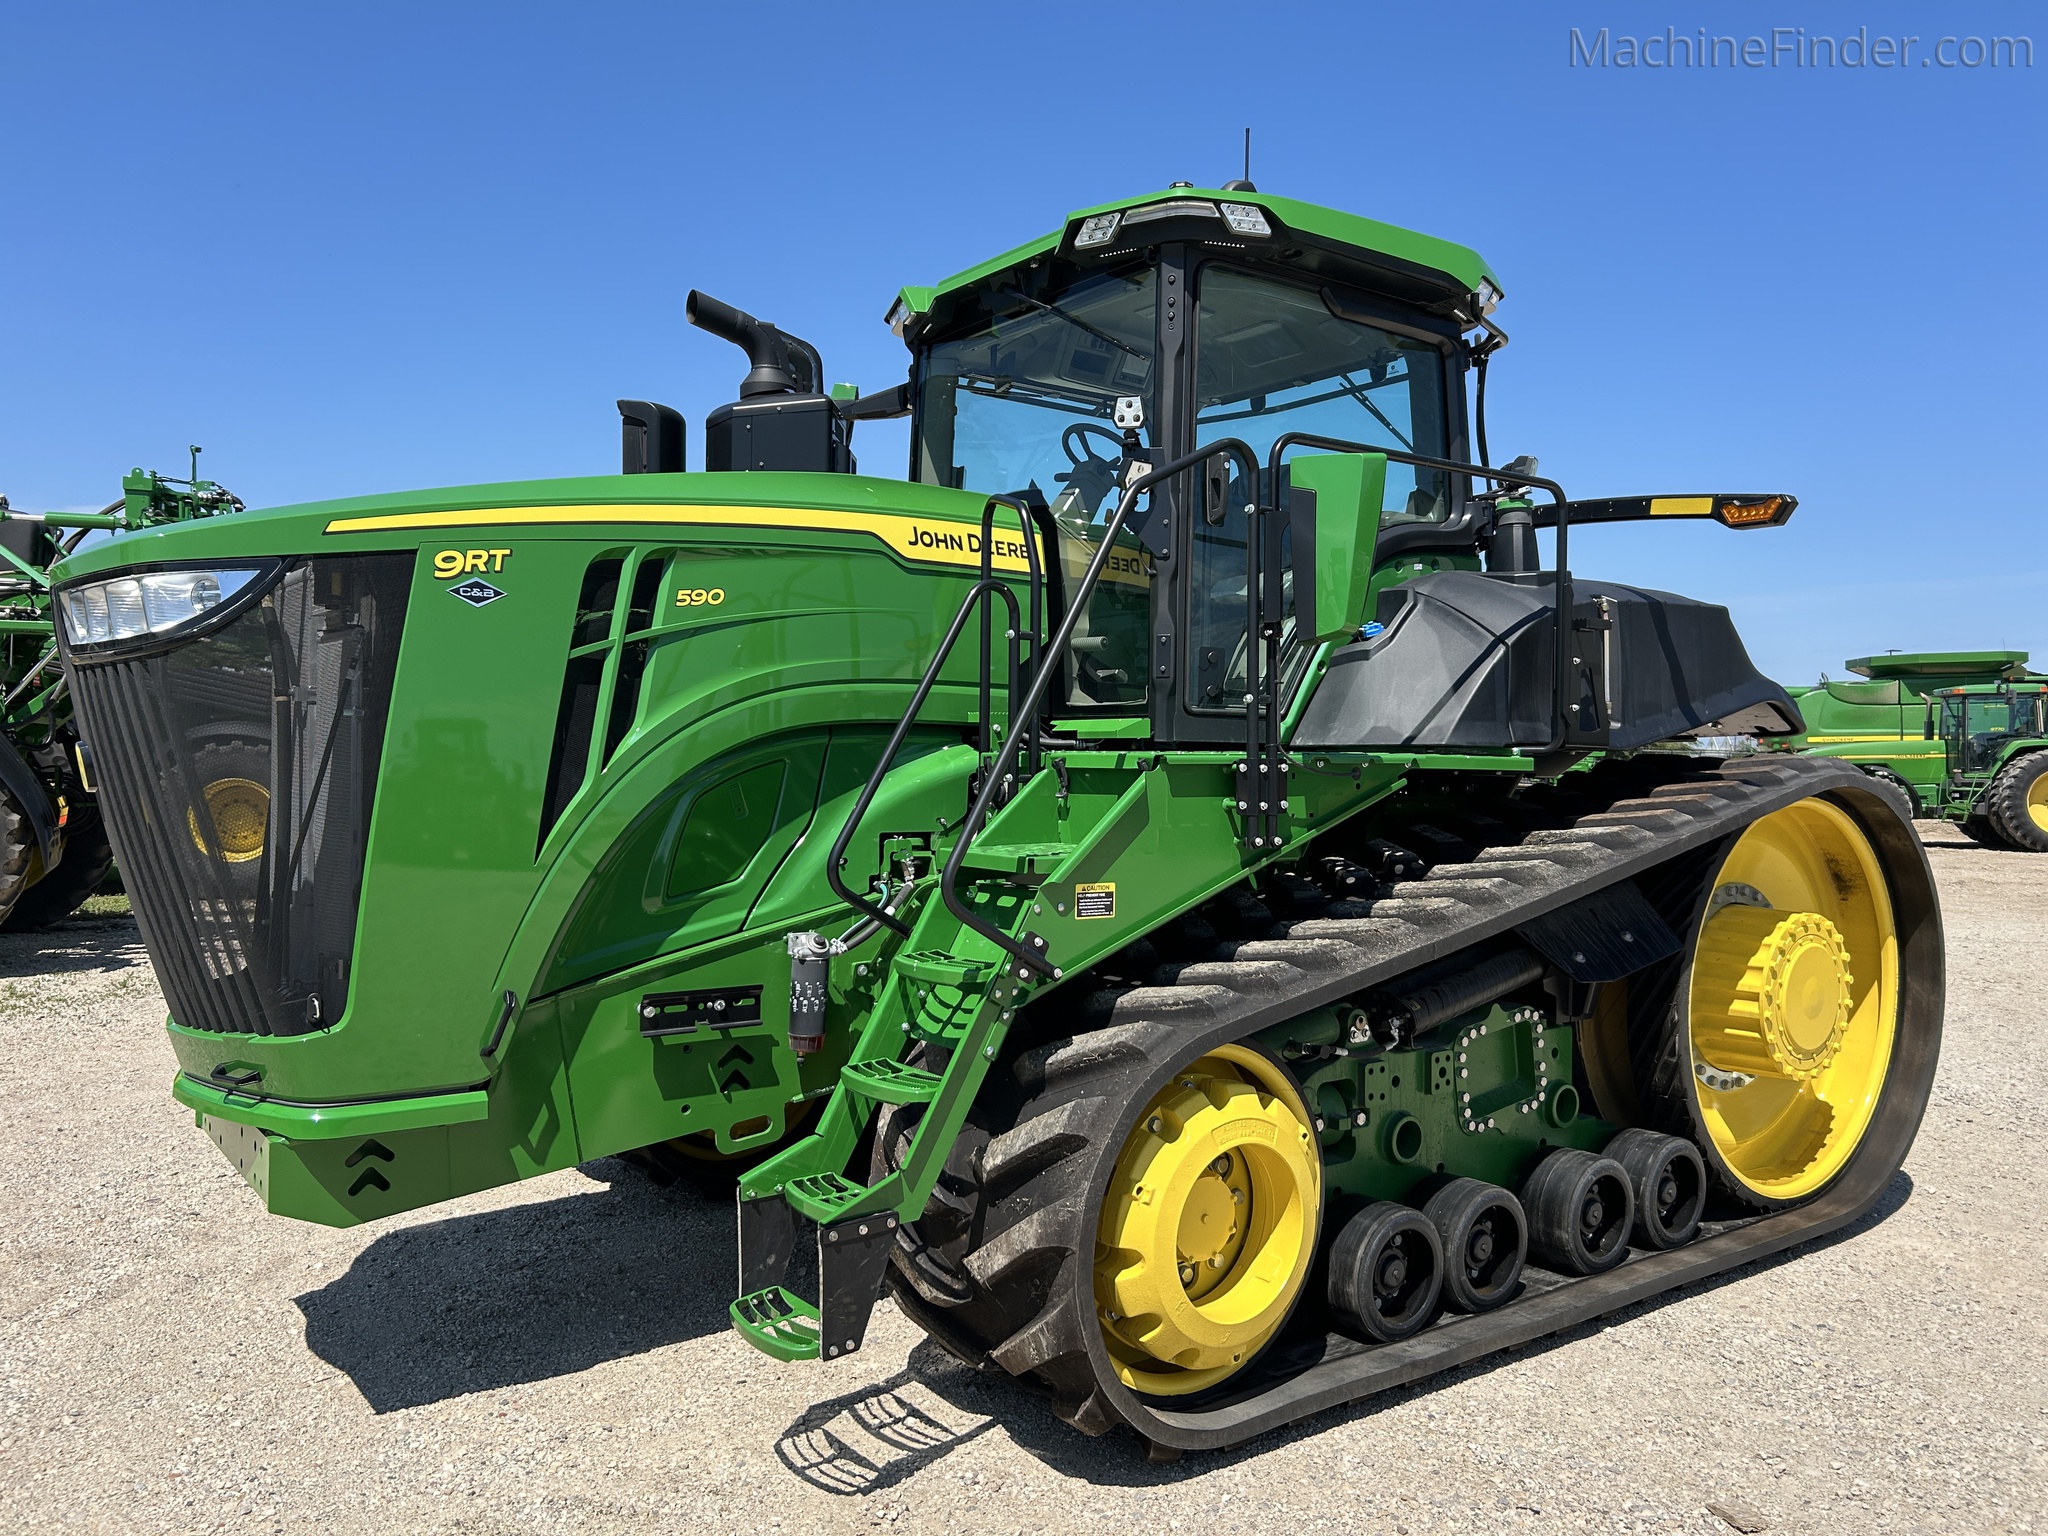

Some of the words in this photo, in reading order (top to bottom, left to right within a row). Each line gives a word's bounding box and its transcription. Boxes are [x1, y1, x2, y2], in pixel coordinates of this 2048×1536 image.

[908, 526, 964, 551] JOHN
[967, 533, 1029, 559] DERE
[433, 549, 512, 580] 9RT
[459, 587, 495, 597] C&B
[675, 588, 726, 607] 590
